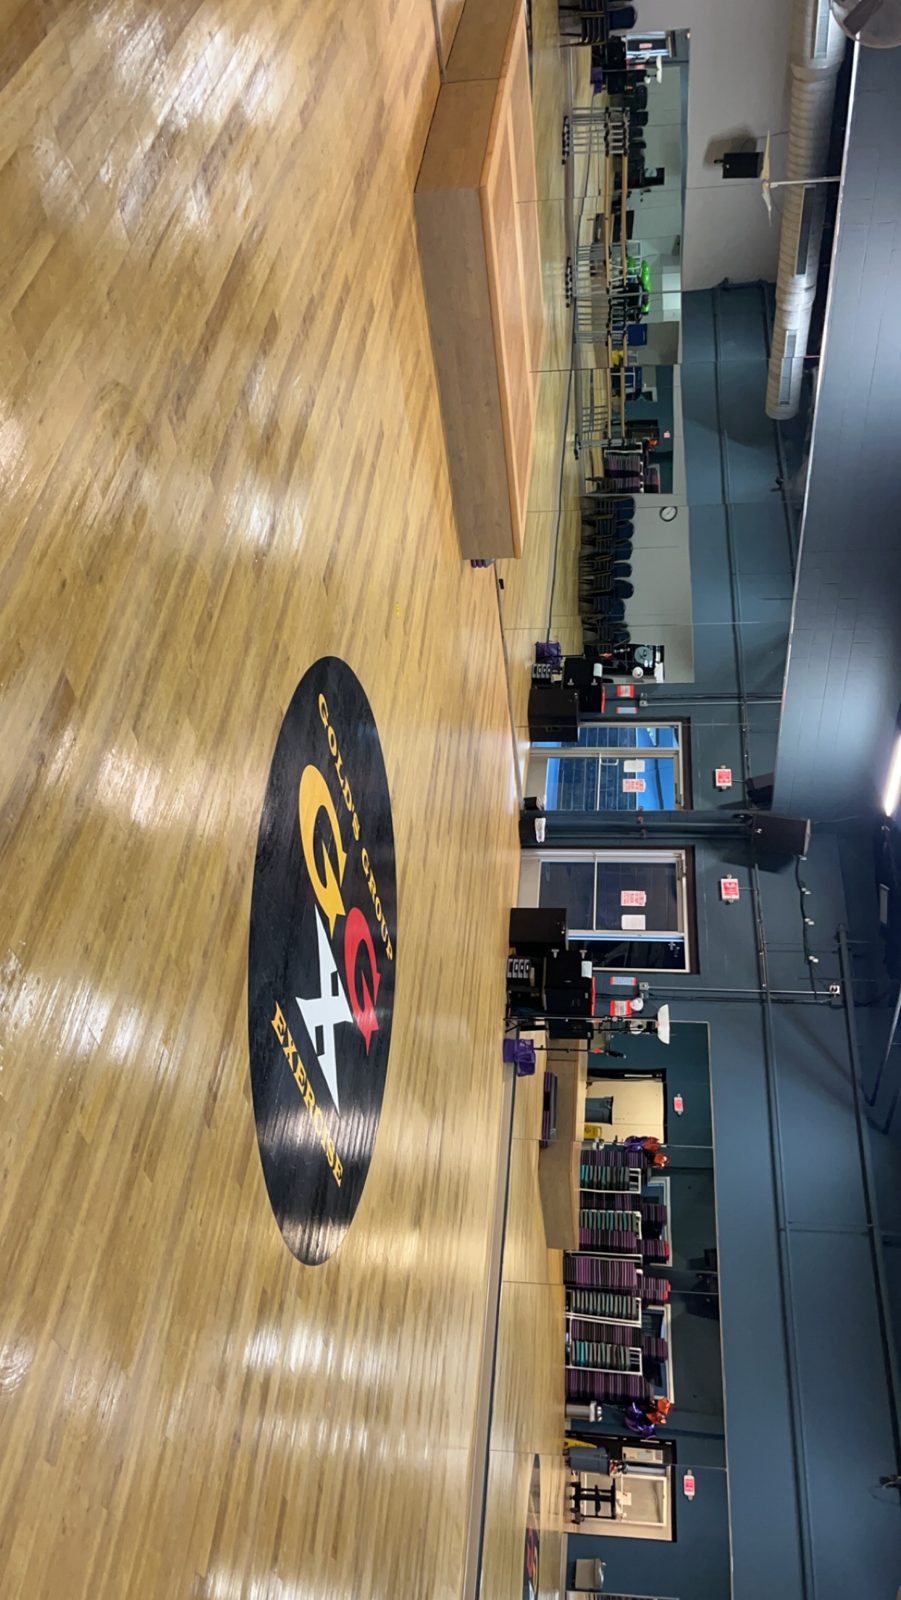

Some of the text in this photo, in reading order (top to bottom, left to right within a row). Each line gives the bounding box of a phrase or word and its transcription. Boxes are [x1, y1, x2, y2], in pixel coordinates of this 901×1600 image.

[318, 693, 394, 961] GOLD'S GROUP
[722, 881, 739, 898] EXIT
[270, 1001, 343, 1188] EXERCISE
